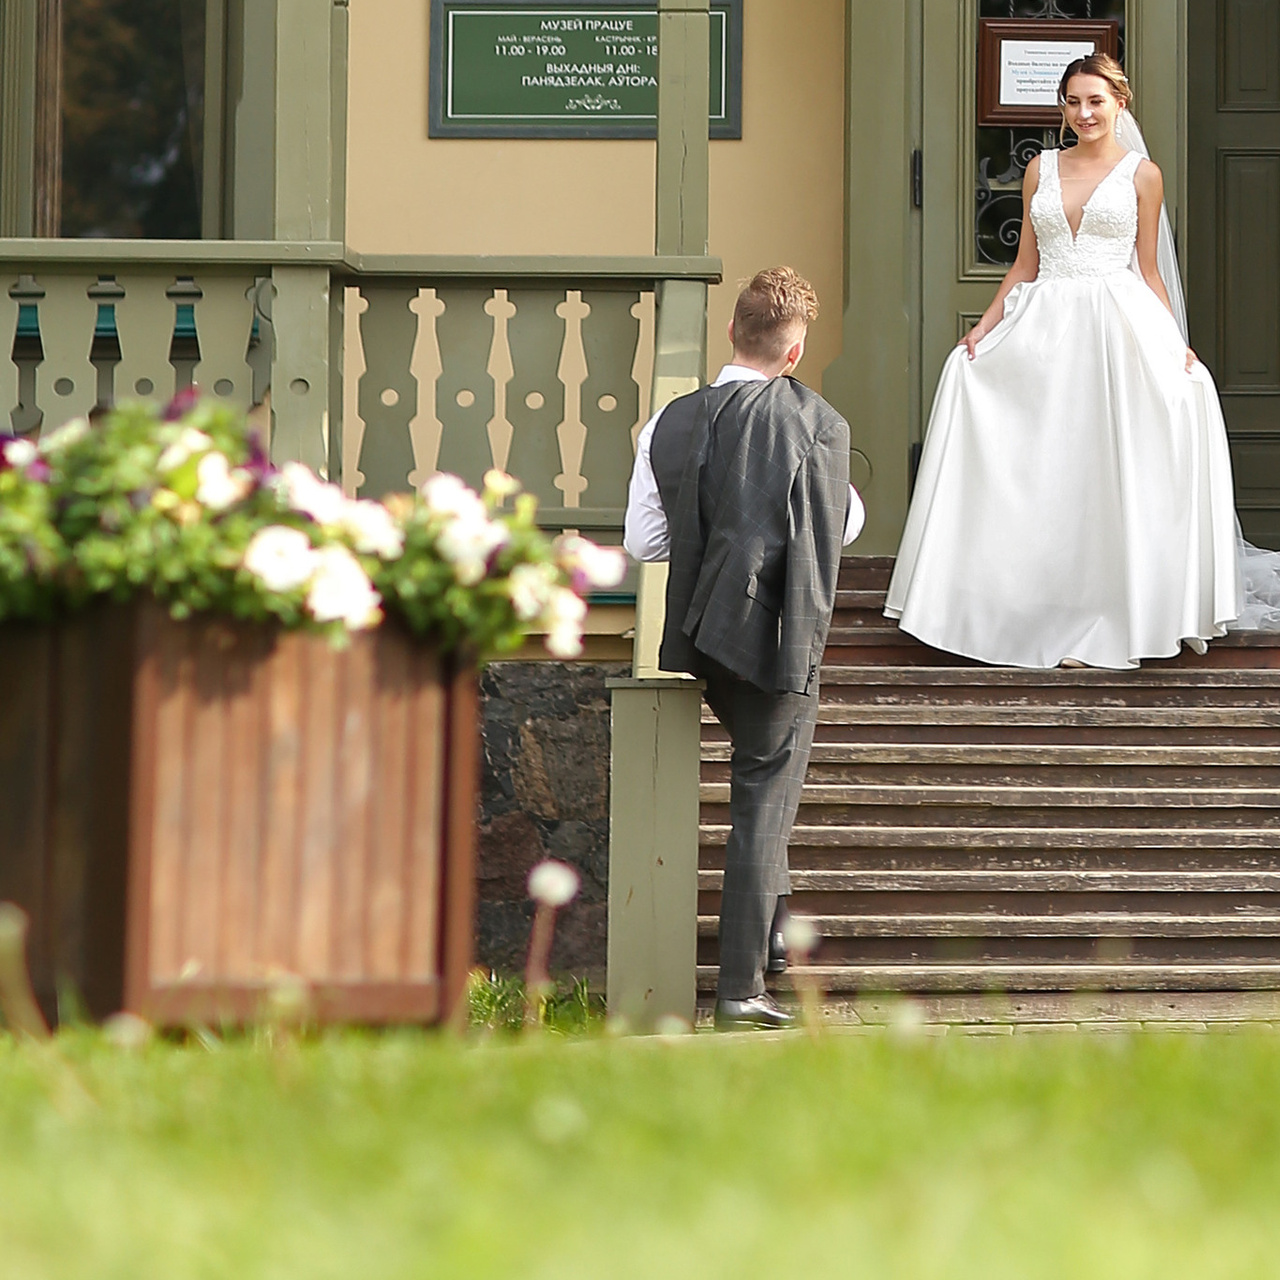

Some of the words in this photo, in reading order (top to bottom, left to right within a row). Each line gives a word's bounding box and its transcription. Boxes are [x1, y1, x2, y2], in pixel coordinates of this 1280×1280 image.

[541, 18, 582, 31] МУЗЕЙ
[585, 20, 633, 32] ПРАЦУЕ
[497, 34, 516, 42] МАЙ
[494, 45, 525, 56] 11.00
[535, 45, 566, 56] 19.00
[605, 45, 636, 56] 11.00
[646, 45, 658, 56] 18
[546, 63, 614, 74] ВЫХАДНЫЯ
[615, 63, 640, 74] ДНІ:
[608, 74, 658, 87] АЎТОРА
